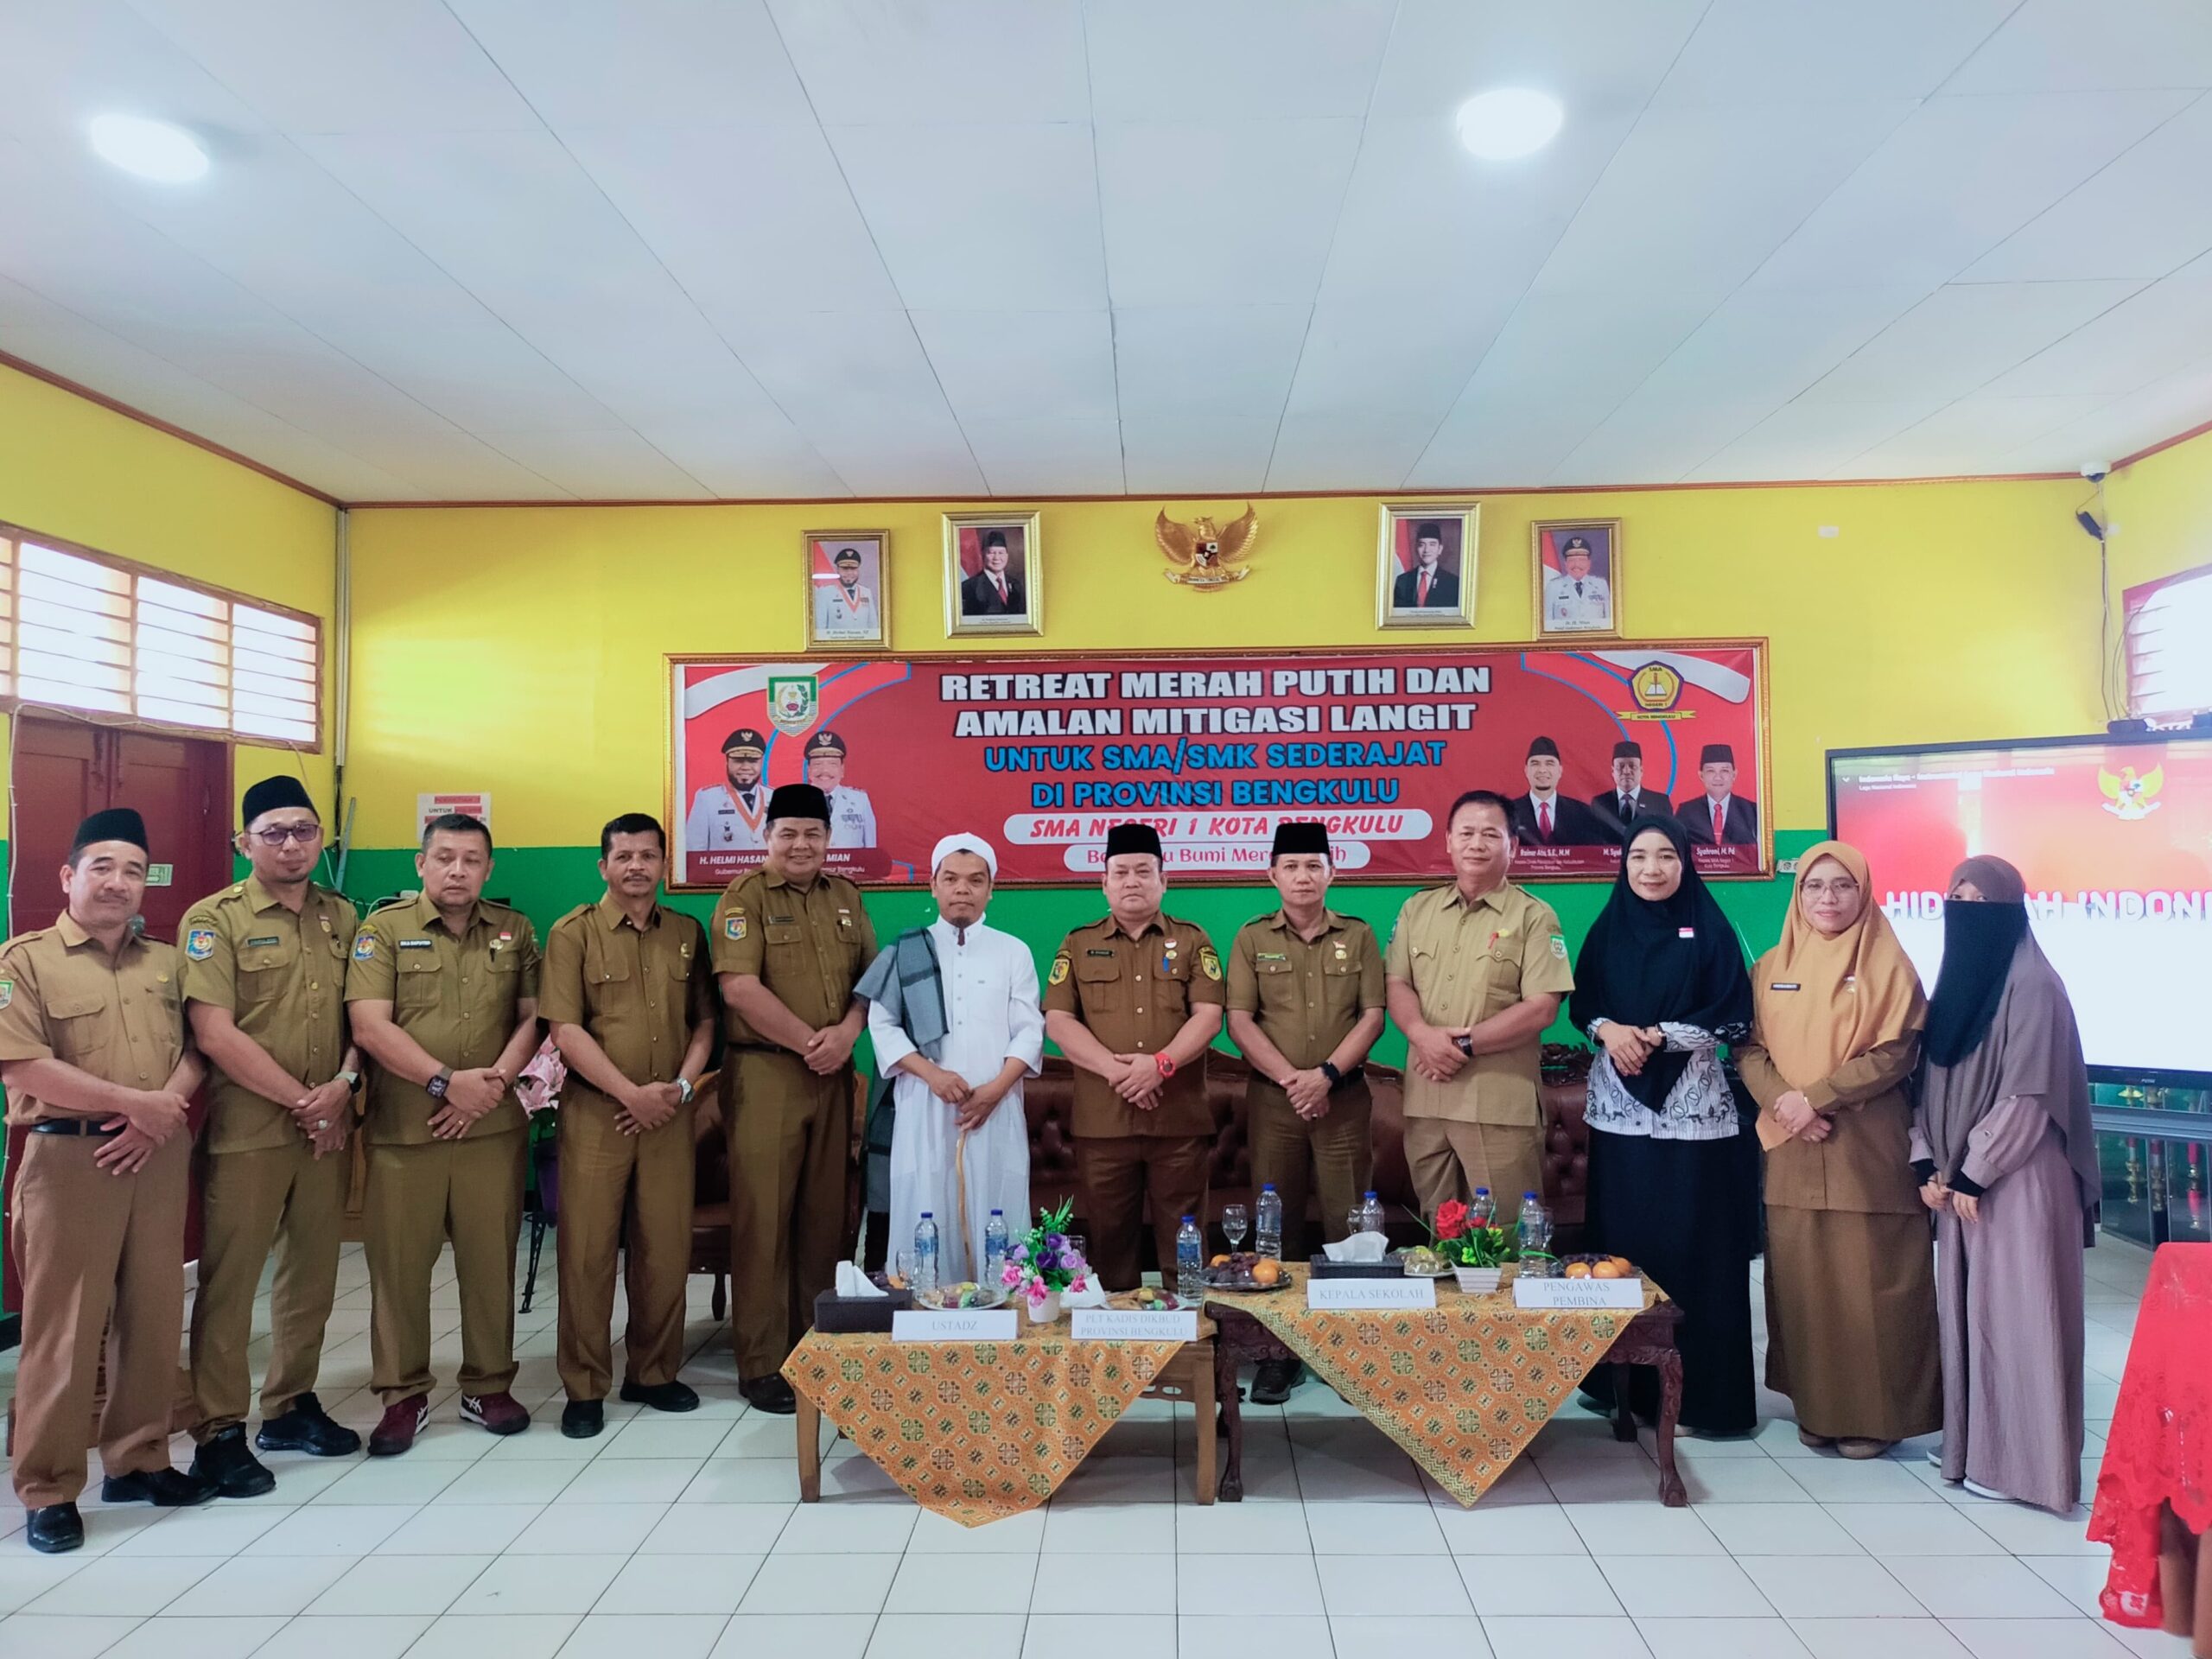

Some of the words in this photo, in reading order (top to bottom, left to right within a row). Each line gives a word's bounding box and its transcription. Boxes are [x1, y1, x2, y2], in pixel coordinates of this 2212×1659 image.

[940, 672, 1113, 702] RETREAT
[1121, 671, 1262, 698] MERAH
[1272, 668, 1395, 696] PUTIH
[1406, 666, 1491, 694] DAN
[955, 709, 1122, 737] AMALAN
[1131, 705, 1321, 734] MITIGASI
[1330, 703, 1477, 732] LANGIT
[984, 745, 1095, 772] UNTUK
[1102, 736, 1258, 775] SMA/SMK
[1266, 741, 1447, 768] SEDERAJAT
[1032, 783, 1064, 808] DI
[1073, 781, 1223, 807] PROVINSI
[1231, 778, 1399, 805] BENGKULU
[1030, 819, 1080, 838] SMA
[1188, 817, 1198, 836] 1
[1208, 817, 1268, 836] KOTA
[709, 855, 736, 865] HELMI
[737, 855, 769, 864] HASAN
[826, 853, 850, 862] MIAN
[1179, 847, 1226, 863] Bumi
[1230, 847, 1274, 862] Mer
[1543, 1282, 1611, 1293] PENGAWAS
[1319, 1289, 1366, 1300] KEPALA
[1369, 1288, 1424, 1300] SEKOLAH
[1553, 1296, 1607, 1306] PEMBINA
[1085, 1313, 1103, 1324] PLT
[1106, 1313, 1138, 1324] KADIS
[1140, 1313, 1180, 1324] DIKBUD
[931, 1320, 978, 1332] USTADZ
[1080, 1326, 1128, 1336] PROVINSI
[1130, 1326, 1187, 1336] BENGKULU
